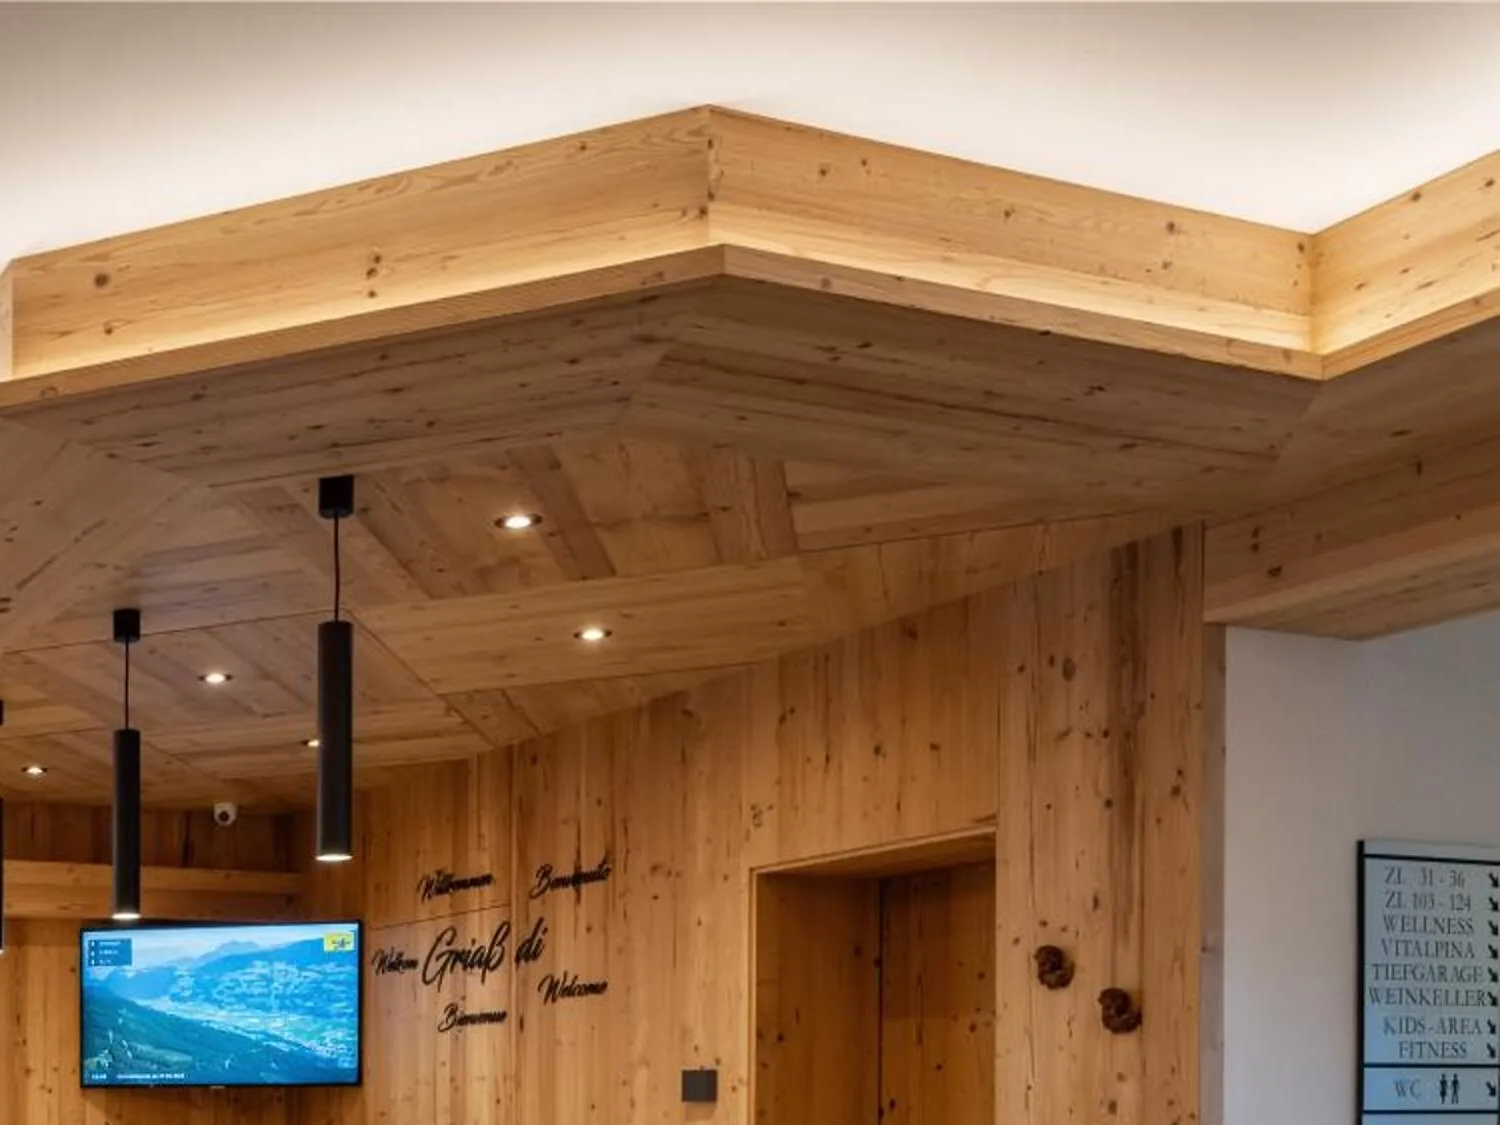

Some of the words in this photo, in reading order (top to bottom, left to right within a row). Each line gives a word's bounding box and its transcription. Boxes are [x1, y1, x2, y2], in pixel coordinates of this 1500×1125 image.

[1450, 893, 1471, 912] 124
[1382, 913, 1474, 934] WELLNESS
[515, 916, 548, 965] di
[1380, 938, 1476, 959] VITALPINA
[1370, 962, 1485, 984] TIEFGARAGE
[537, 972, 608, 1005] Welcome
[1368, 986, 1489, 1007] WEINKELLER
[1398, 1041, 1468, 1059] FITNESS
[1393, 1078, 1421, 1099] WC
